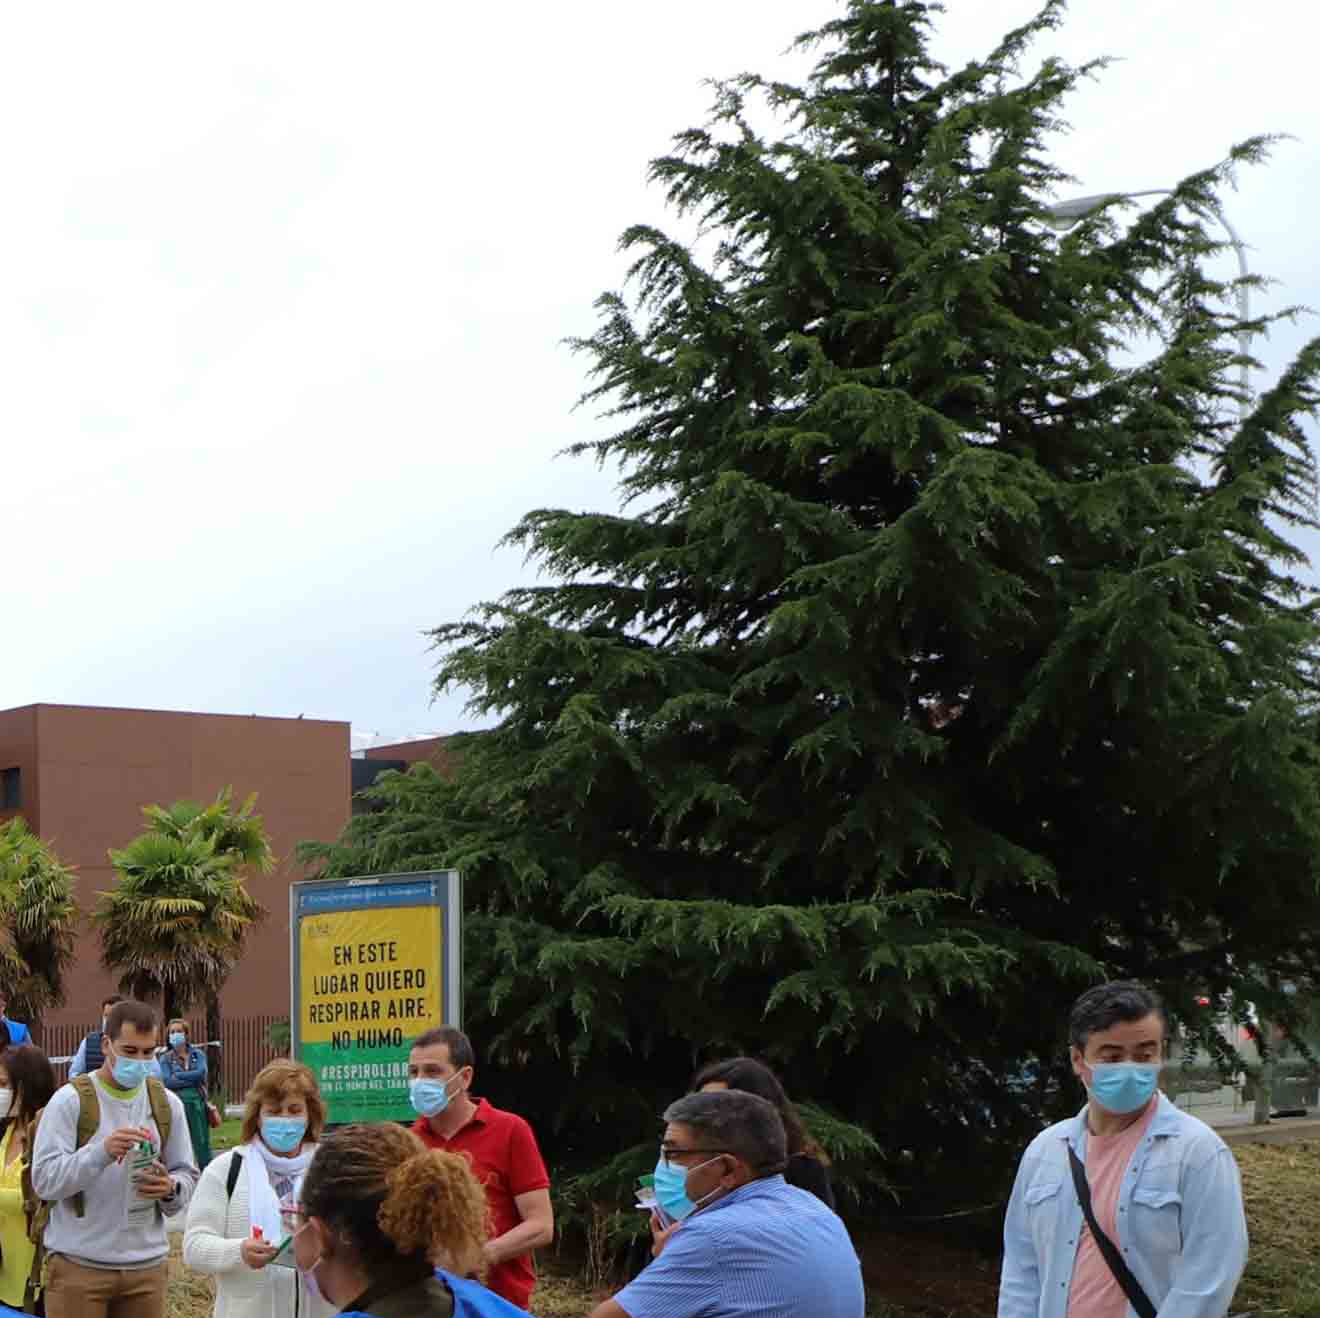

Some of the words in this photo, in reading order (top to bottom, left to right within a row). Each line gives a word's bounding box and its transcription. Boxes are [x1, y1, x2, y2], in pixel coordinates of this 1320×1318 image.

[334, 945, 352, 966] EN
[358, 941, 398, 963] ESTE
[313, 973, 359, 996] LUGAR
[365, 968, 426, 994] QUIERO
[309, 999, 381, 1025] RESPIRAR
[331, 1031, 352, 1051] NO
[356, 1027, 403, 1049] HUMO
[320, 1062, 409, 1081] #RESPIROLIBR
